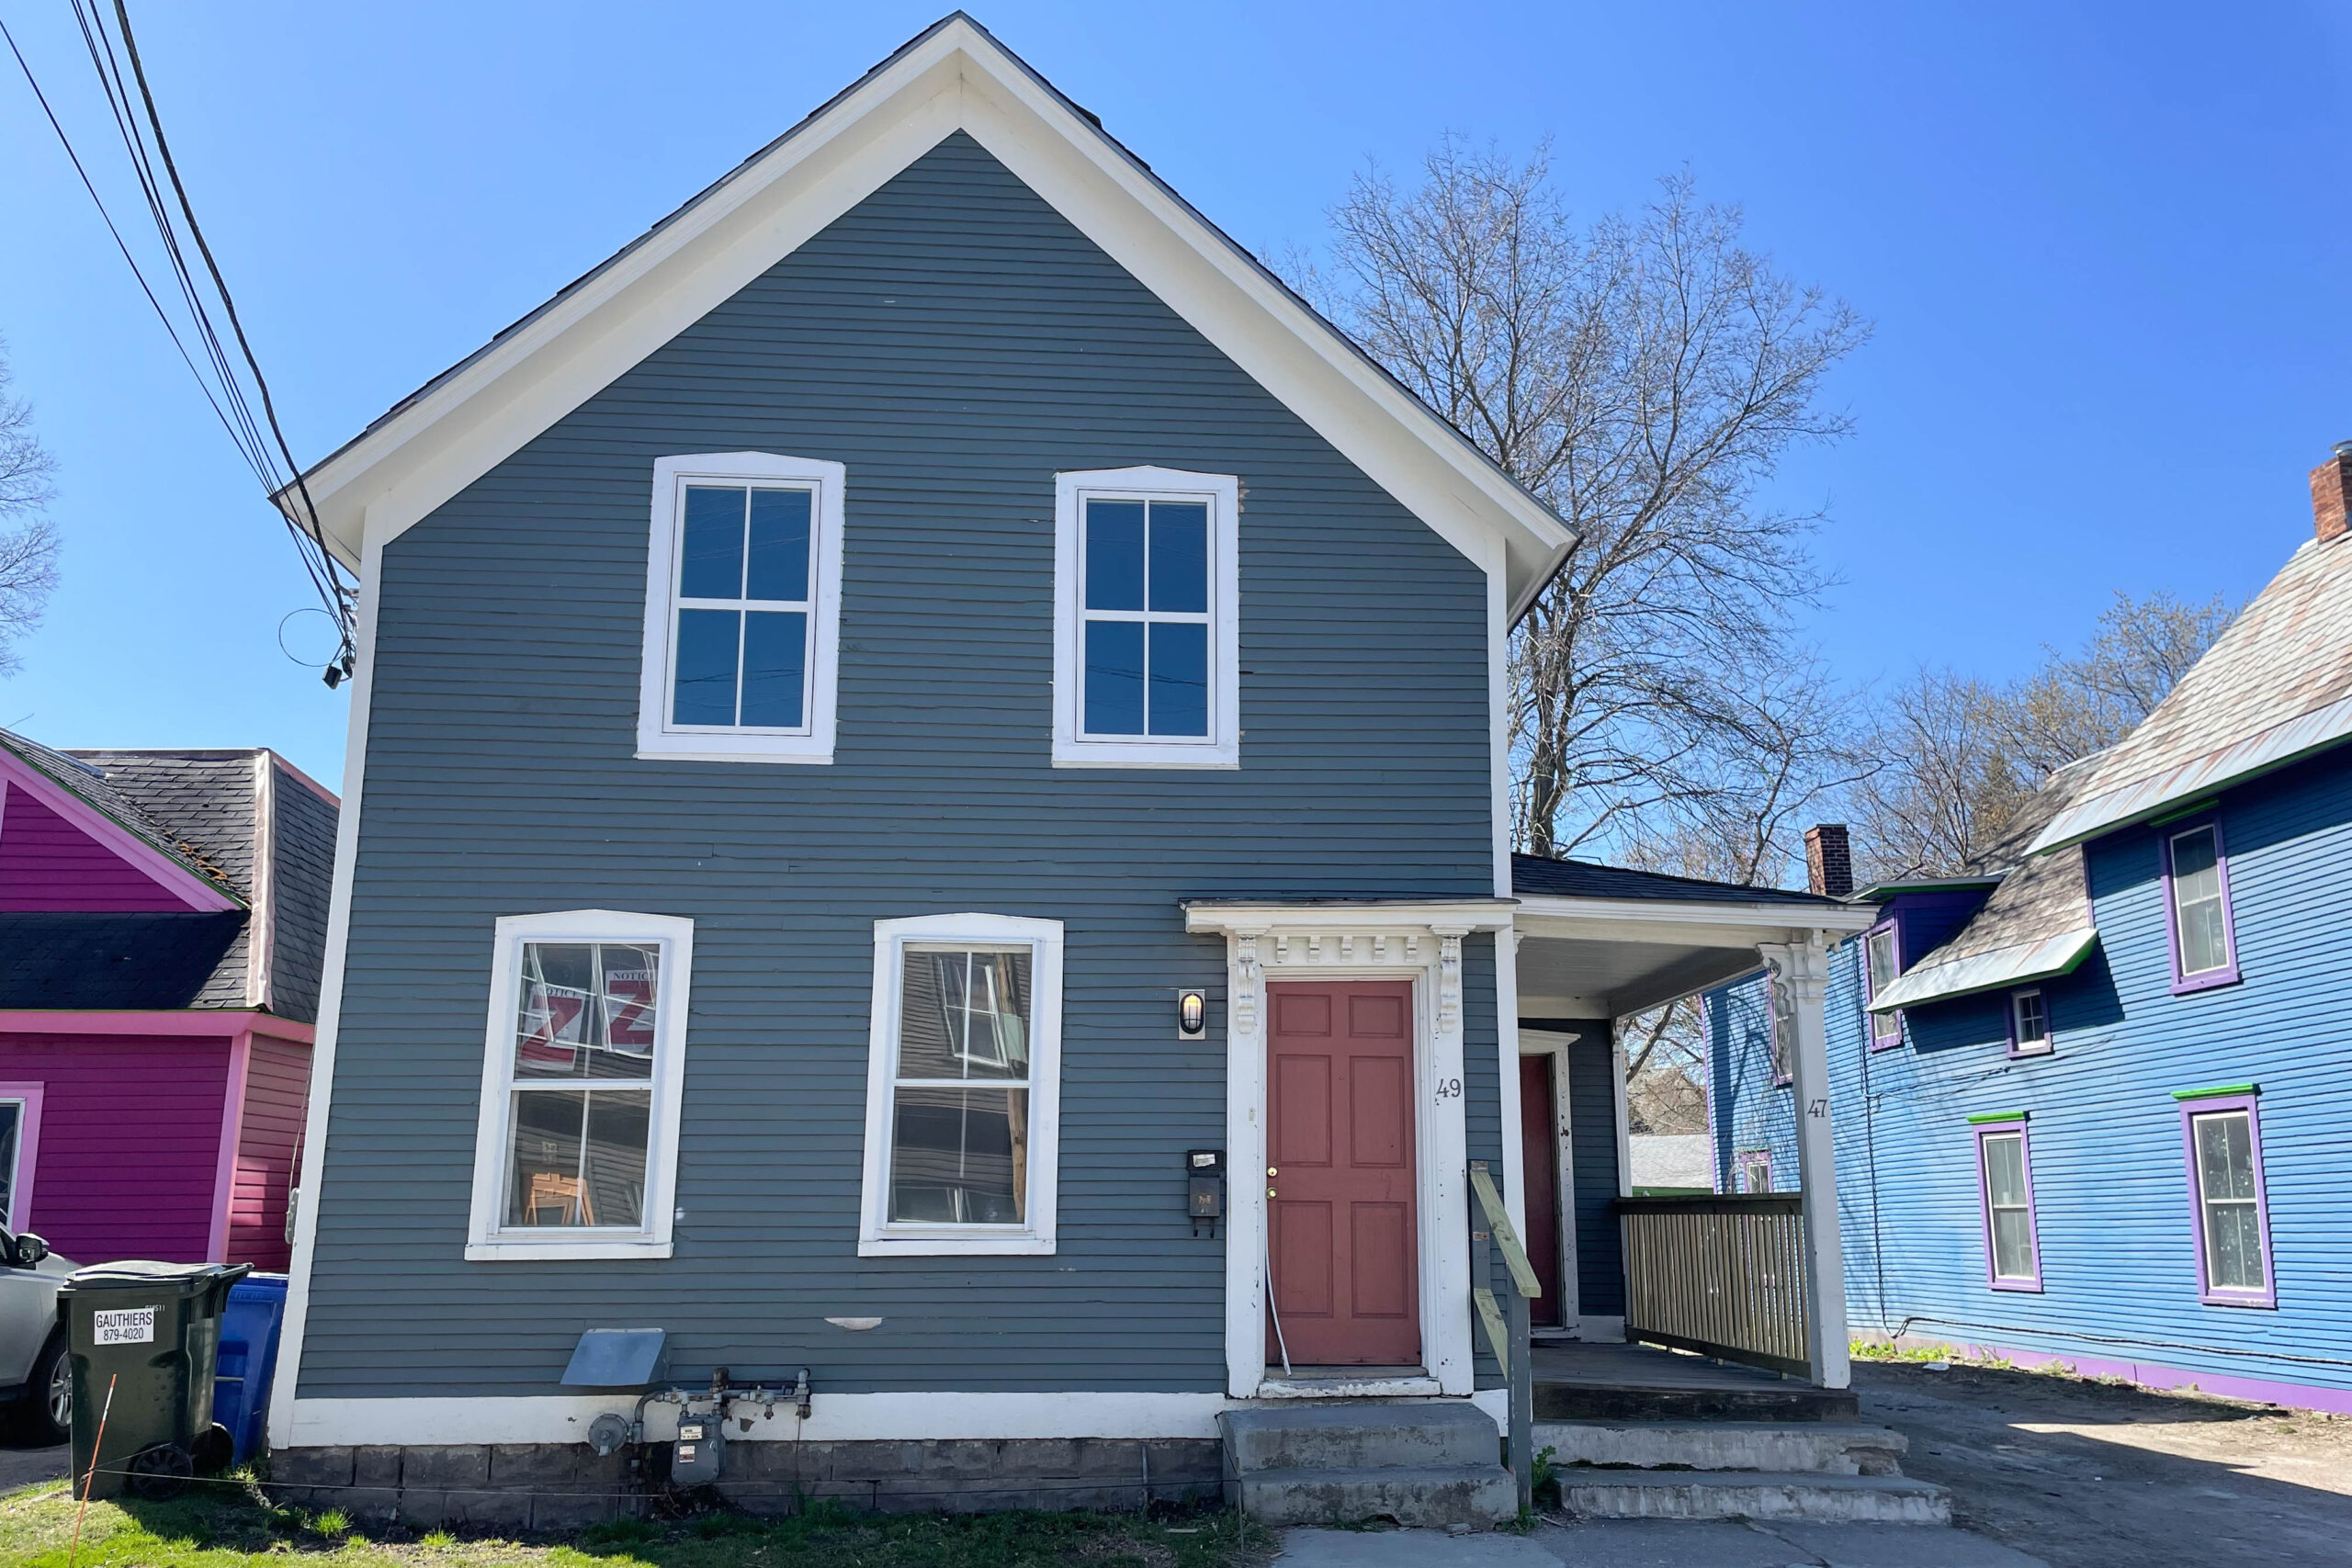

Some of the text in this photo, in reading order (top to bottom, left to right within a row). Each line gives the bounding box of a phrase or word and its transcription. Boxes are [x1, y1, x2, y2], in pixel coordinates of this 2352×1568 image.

[1436, 1078, 1461, 1098] 49
[1807, 1099, 1827, 1118] 47
[96, 1312, 153, 1328] GAUTHIERS
[103, 1327, 144, 1341] 879-4020
